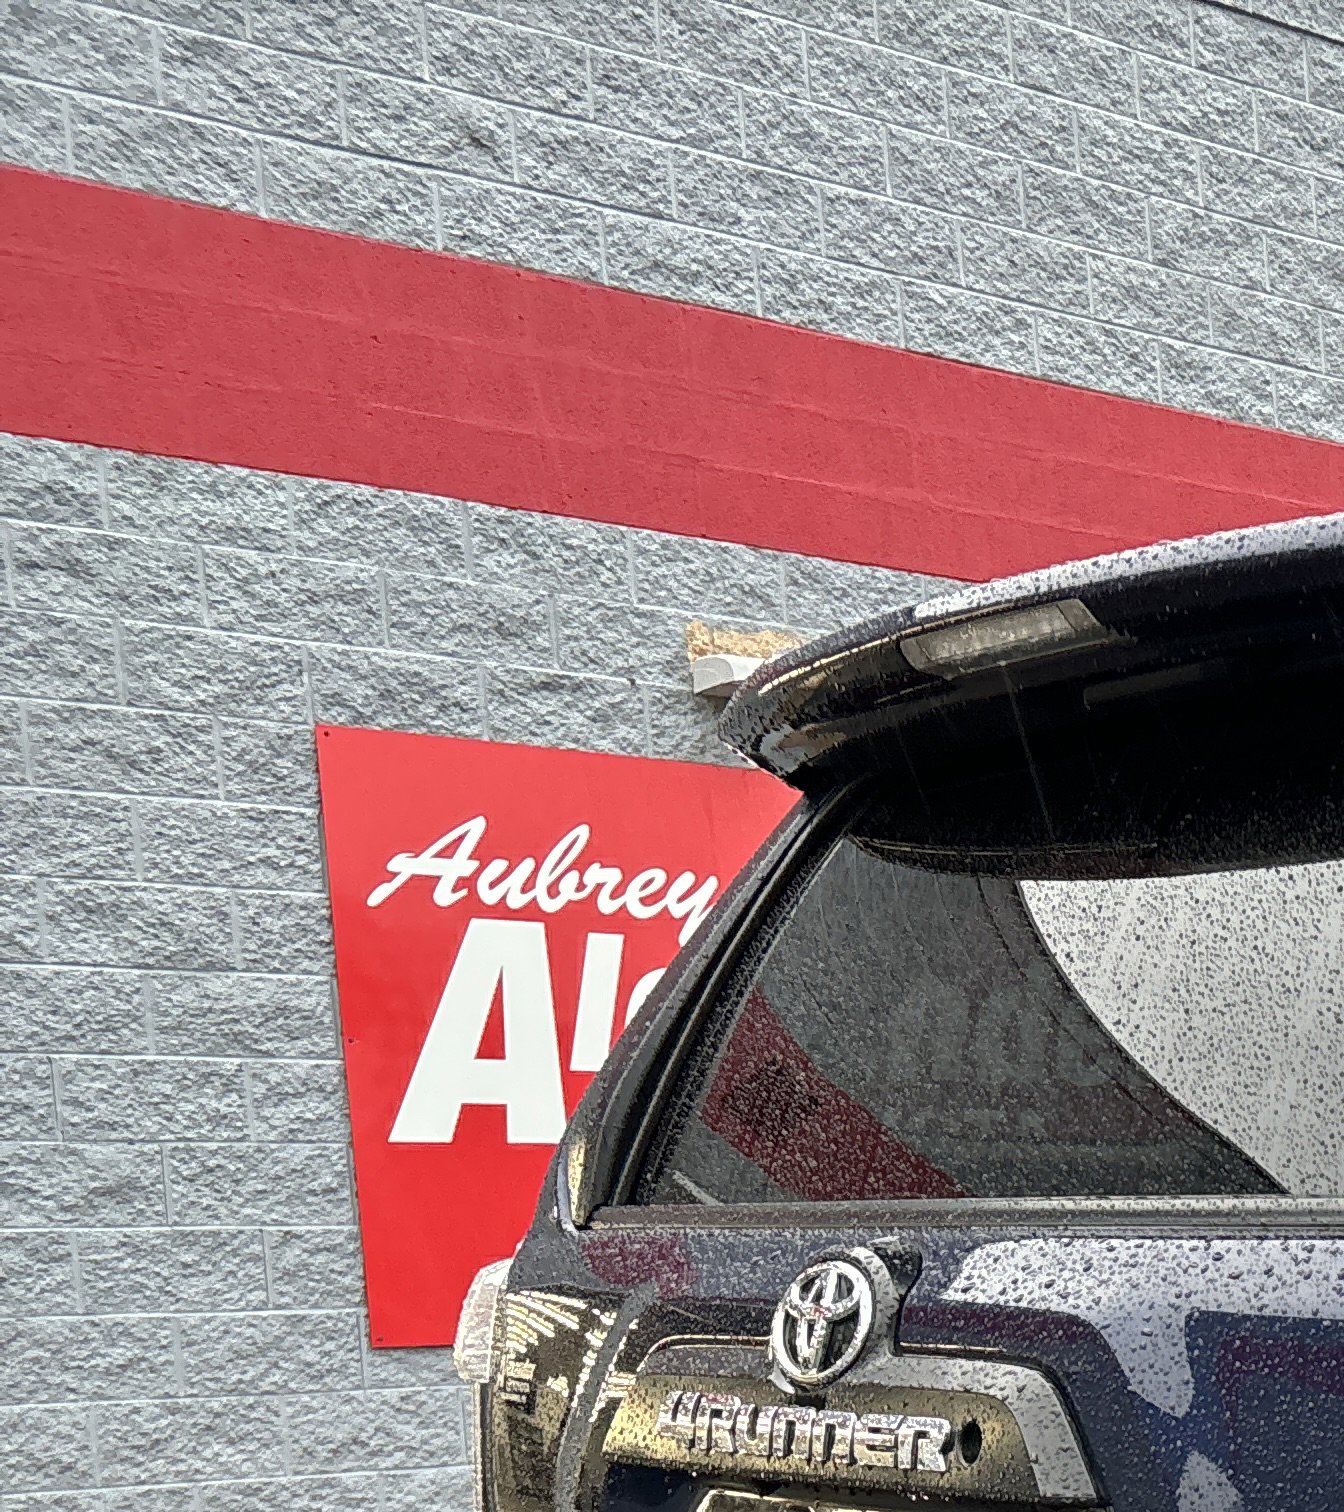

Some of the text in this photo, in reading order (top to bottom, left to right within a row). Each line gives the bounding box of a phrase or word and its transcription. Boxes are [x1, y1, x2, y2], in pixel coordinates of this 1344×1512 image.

[367, 815, 720, 948] Aubrey
[388, 917, 668, 1144] Al
[655, 1390, 951, 1473] 4RUNNER
